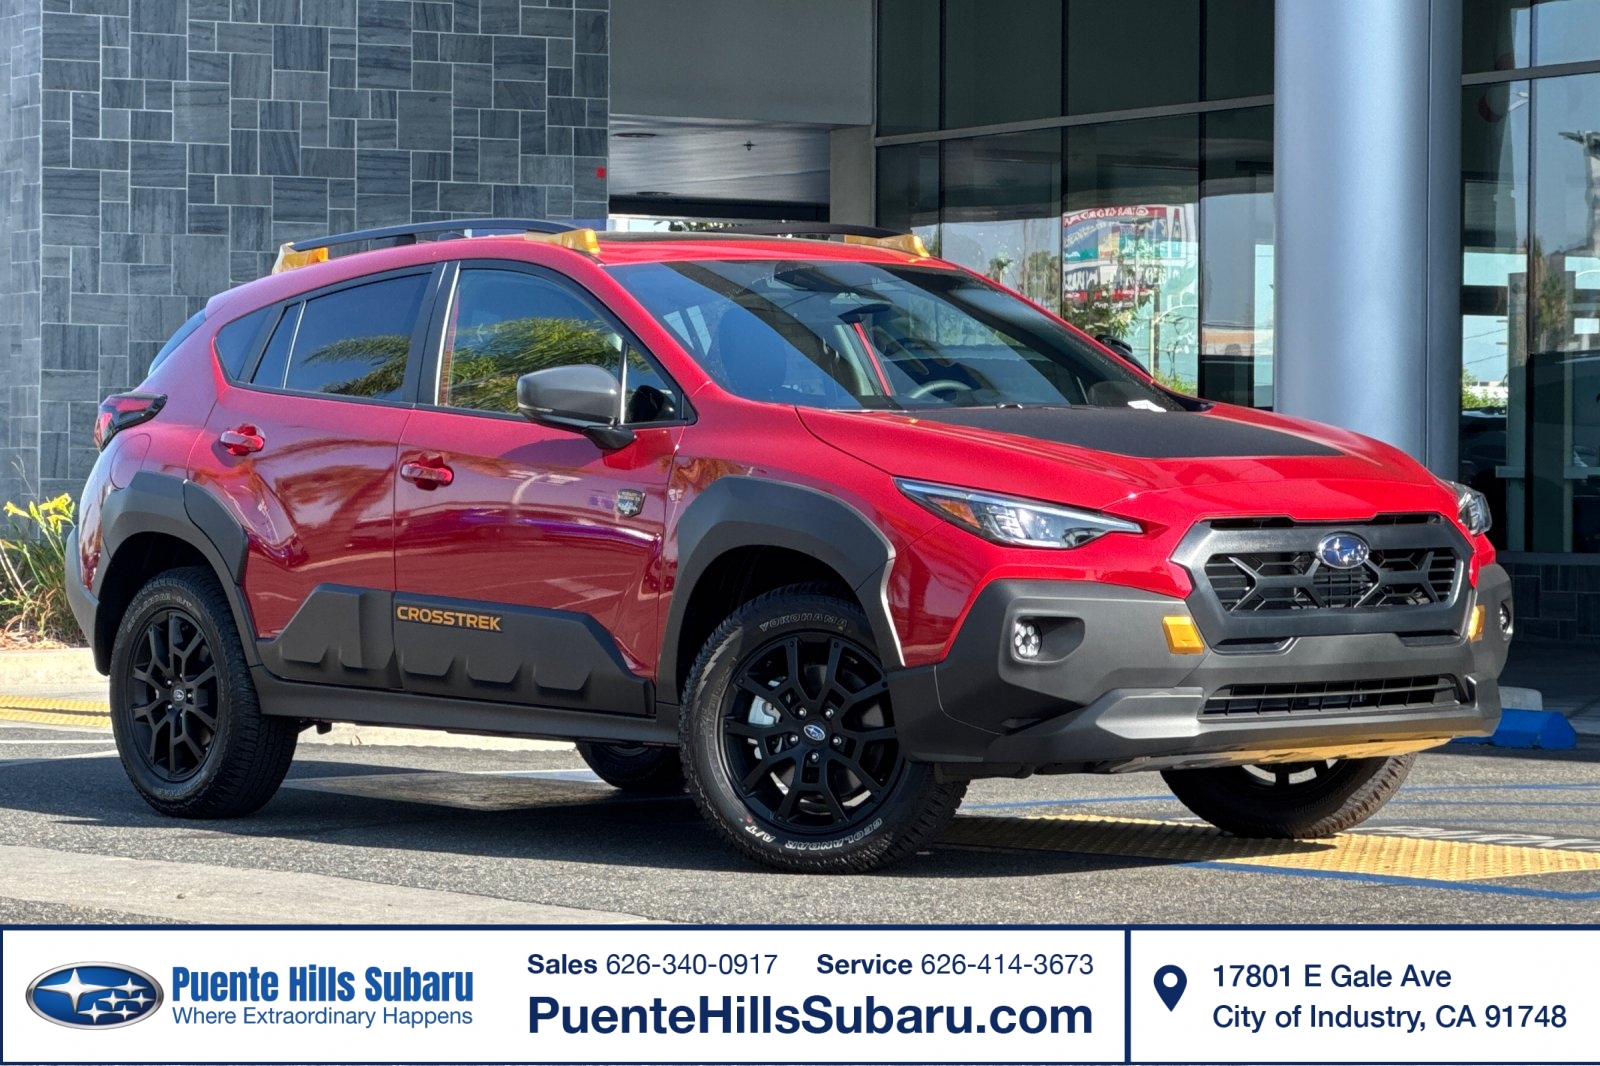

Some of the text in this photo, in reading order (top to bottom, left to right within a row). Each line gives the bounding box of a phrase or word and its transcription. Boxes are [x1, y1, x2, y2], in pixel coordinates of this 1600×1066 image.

[396, 606, 502, 632] CROSSTREK
[759, 612, 848, 632] YOKOHAMA
[744, 817, 883, 851] GEOLANDAR A/T
